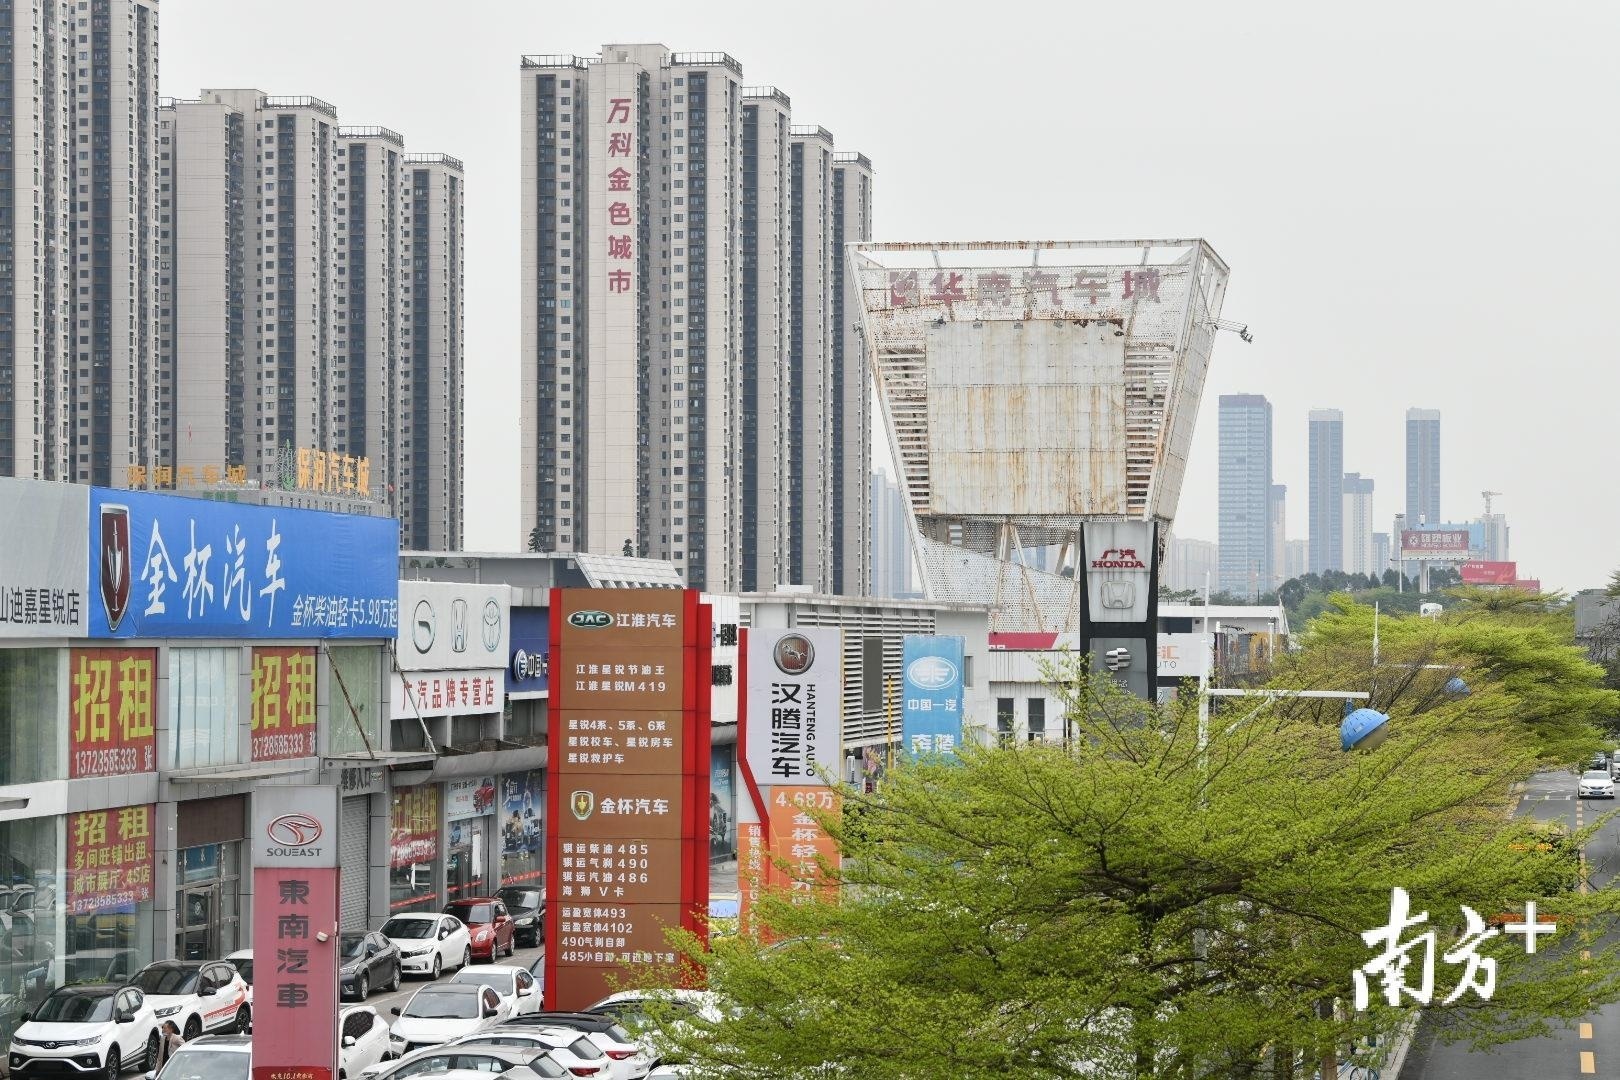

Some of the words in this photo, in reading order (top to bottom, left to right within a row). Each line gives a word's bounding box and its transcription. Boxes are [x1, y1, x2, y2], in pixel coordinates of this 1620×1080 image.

[607, 98, 632, 294] 万科金色城市
[140, 518, 286, 628] 金杯汽车
[1091, 560, 1146, 569] HONDA
[573, 613, 608, 625] JAC
[616, 612, 677, 628] 江淮汽车
[576, 664, 665, 675] 江淮星锐节油王
[74, 655, 154, 742] 招租
[251, 652, 317, 730] 招租
[402, 676, 495, 711] 广汽品牌专营店
[907, 699, 957, 711] 中国一汽
[771, 682, 802, 778] 汉腾汽车
[806, 684, 816, 741] HANTENG
[806, 744, 816, 777] AUTO
[601, 798, 669, 814] 金杯汽车
[74, 807, 150, 846] 招租
[266, 847, 322, 857] SOUEAST
[277, 880, 309, 1008] 東南汽車
